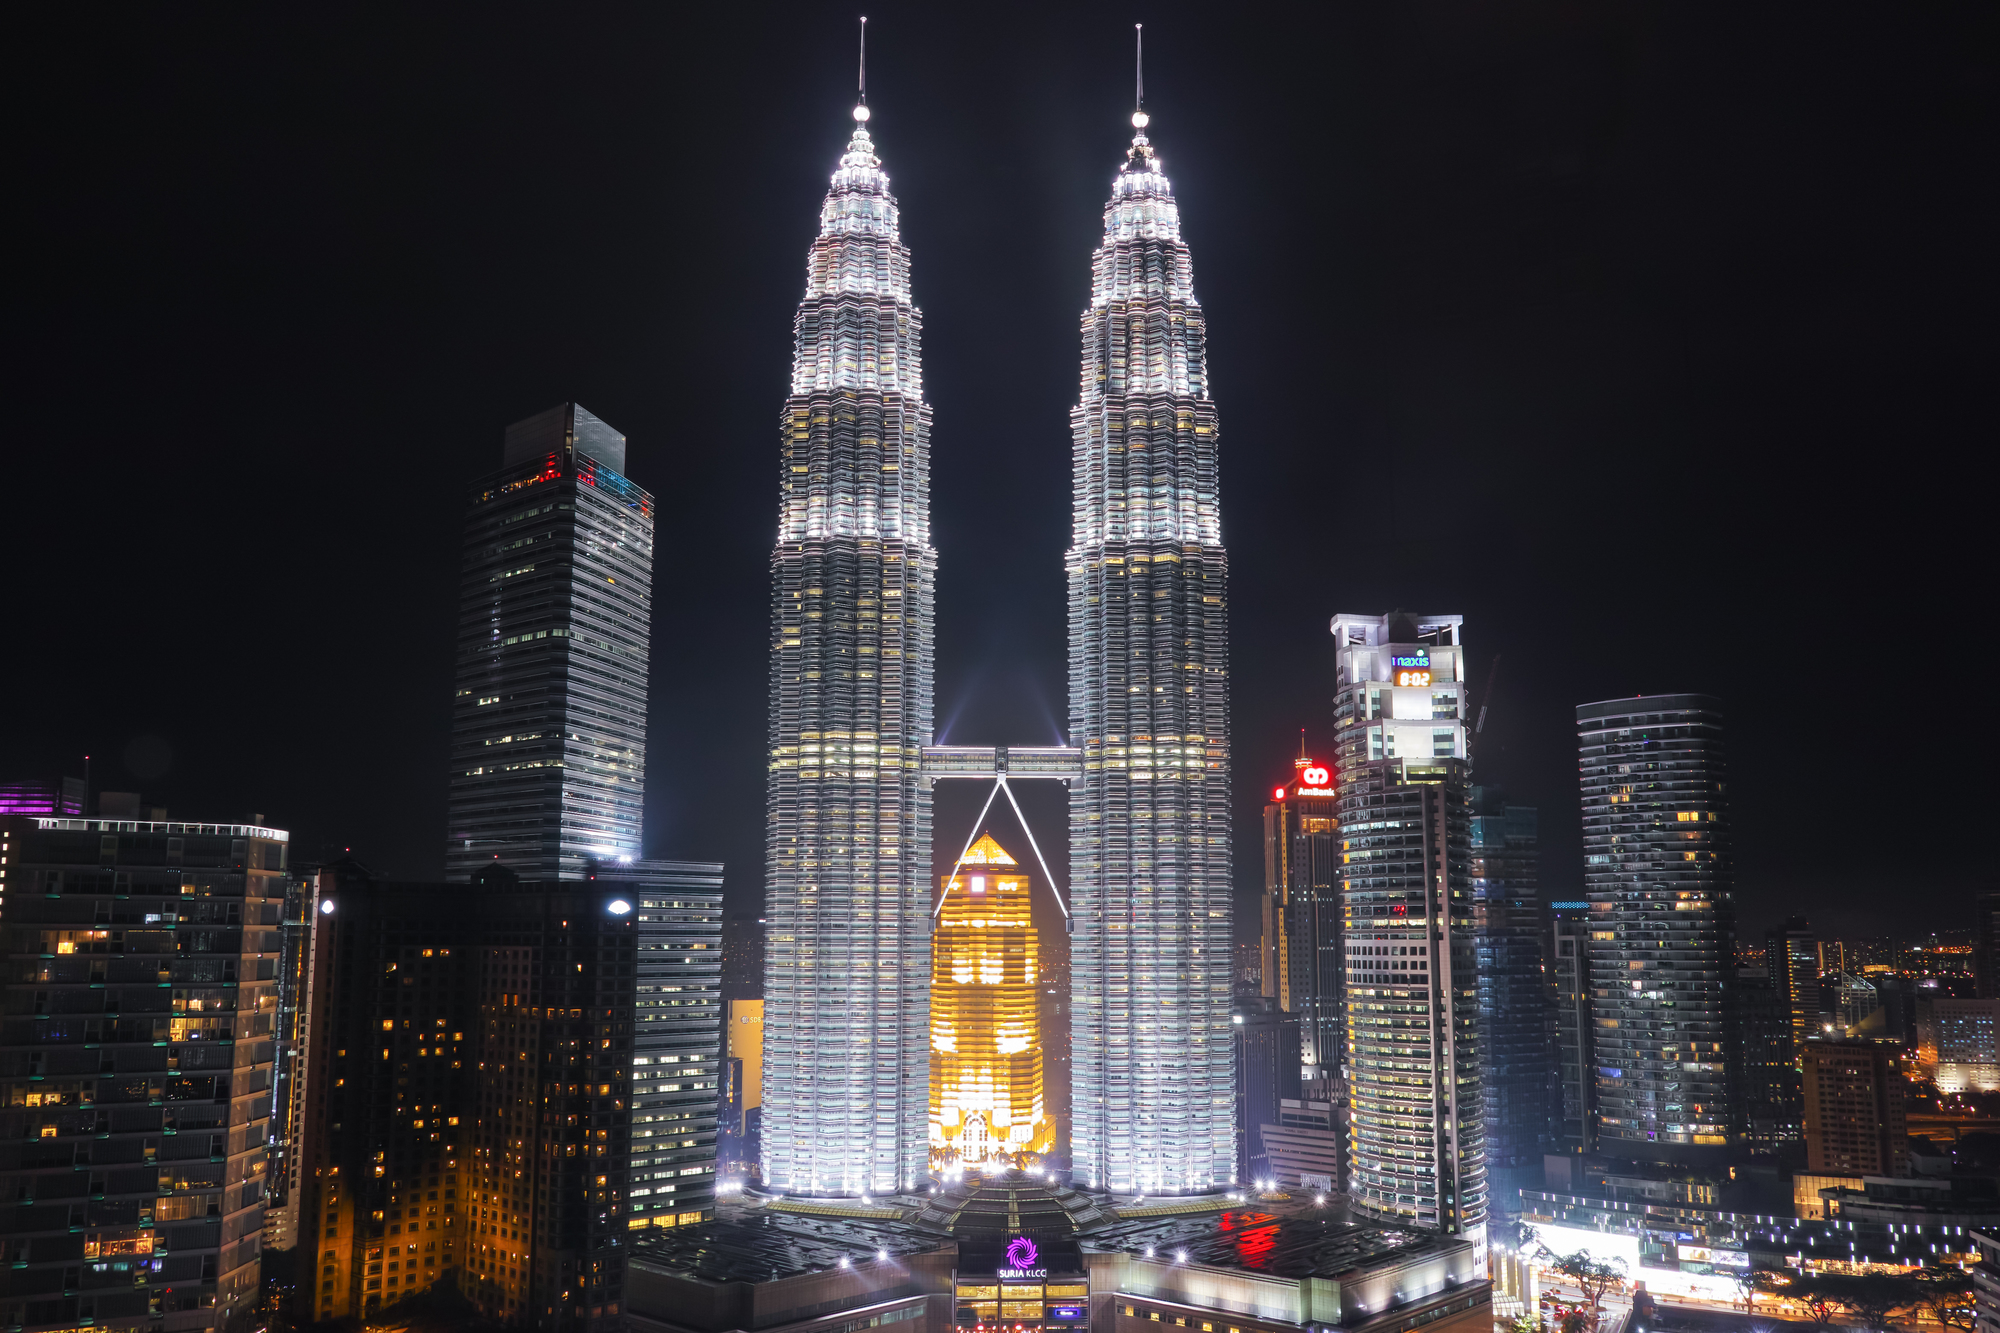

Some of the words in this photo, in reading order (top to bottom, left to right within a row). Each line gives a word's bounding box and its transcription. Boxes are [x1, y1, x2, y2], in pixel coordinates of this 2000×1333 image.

[1400, 672, 1430, 686] 8:02
[1298, 787, 1335, 796] AmBank
[999, 1269, 1025, 1278] SURIA
[1025, 1269, 1046, 1278] KLCC
